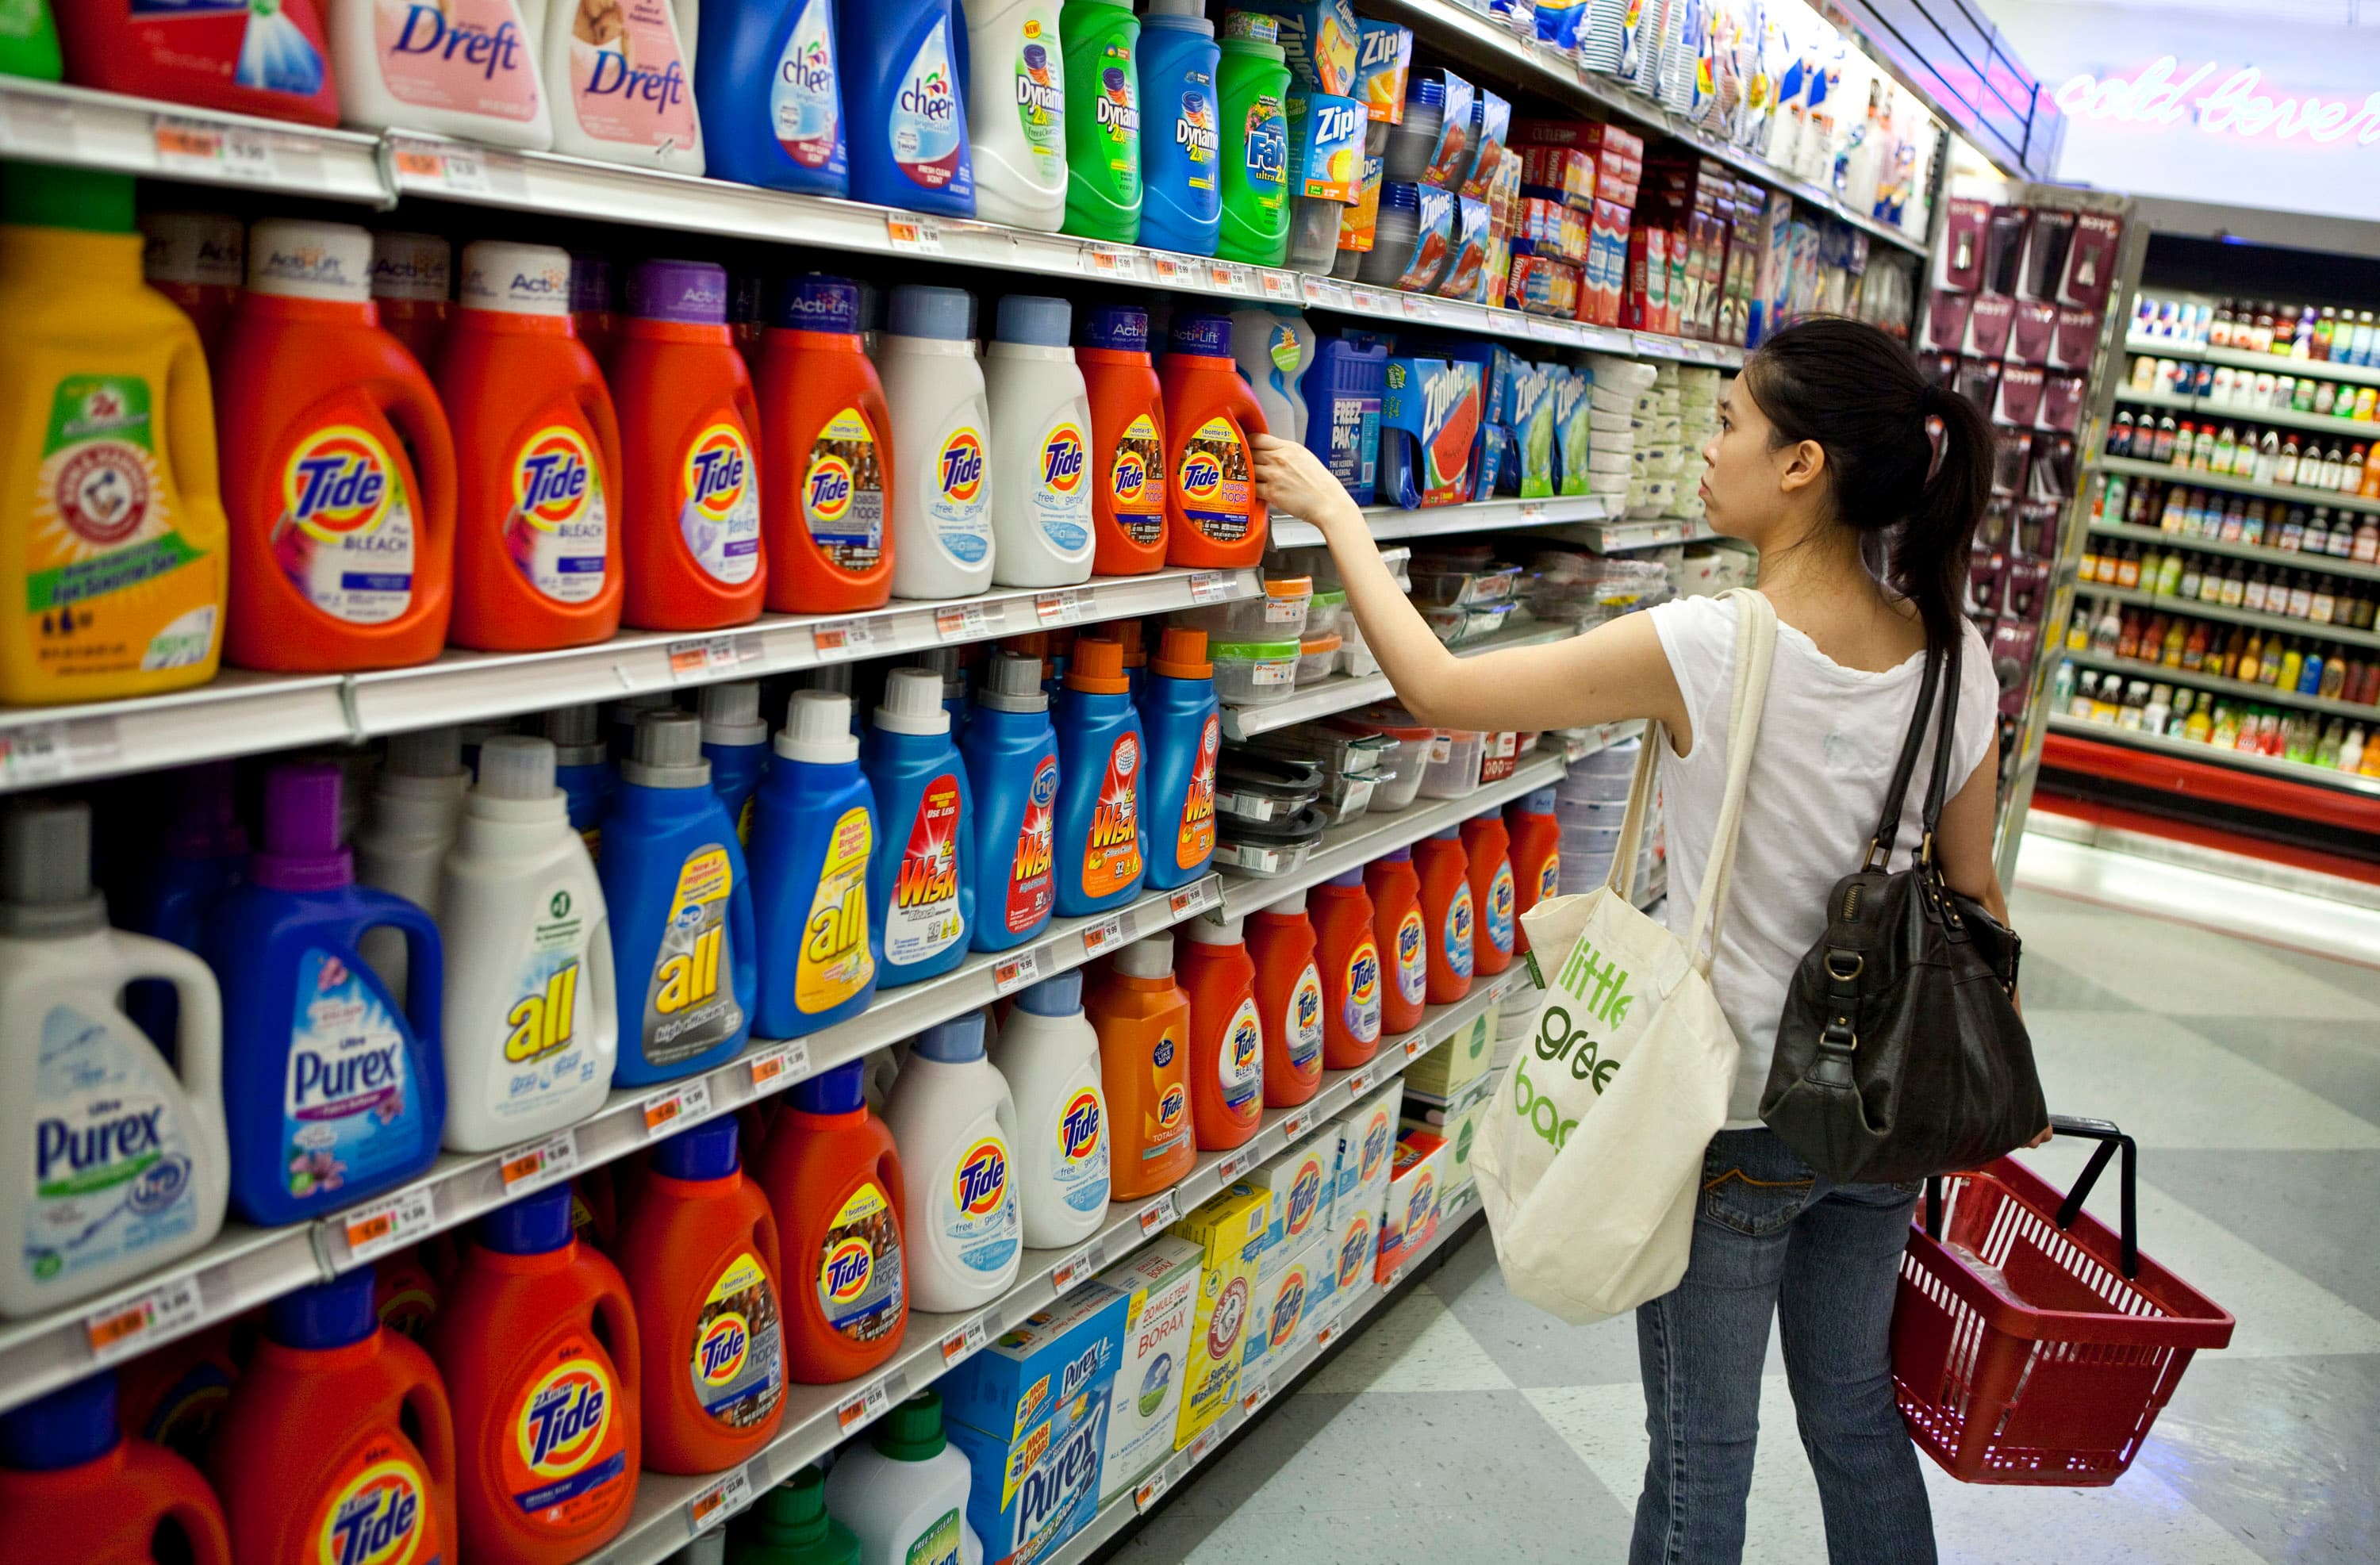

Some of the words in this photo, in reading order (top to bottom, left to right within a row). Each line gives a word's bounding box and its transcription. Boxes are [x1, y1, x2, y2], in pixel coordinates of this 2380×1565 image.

[393, 3, 520, 79] Dreft
[585, 50, 683, 113] Dreft
[784, 47, 833, 93] cheer
[901, 77, 953, 121] cheer
[2056, 55, 2217, 125] cold
[1096, 95, 1139, 133] Dynamo
[1176, 118, 1219, 151] Dynamo
[1189, 144, 1203, 163] 2x
[1247, 130, 1287, 171] Fab
[918, 165, 935, 175] FRESH
[935, 168, 951, 178] CLEAN
[927, 175, 942, 185] SCENT
[1256, 171, 1275, 182] ultra
[1422, 194, 1451, 232] Ziploc
[1462, 206, 1488, 243] Ziploc
[1334, 400, 1362, 424] FREEZ
[1422, 363, 1465, 446] Ziploc
[1514, 369, 1548, 426] Ziploc
[1556, 374, 1585, 426] Ziploc
[1332, 425, 1351, 451] PAK
[693, 450, 744, 504] Tide
[942, 447, 982, 493] Tide
[1046, 441, 1083, 484] Tide
[1115, 464, 1143, 494] Tide
[1184, 464, 1220, 492] Tide
[294, 457, 385, 520] Tide
[522, 453, 589, 512] Tide
[811, 473, 850, 508] Tide
[1038, 493, 1055, 503] free
[1144, 490, 1163, 504] hope
[1222, 490, 1249, 504] hope
[1223, 481, 1244, 492] loads
[342, 534, 409, 553] BLEACH
[557, 524, 605, 541] BLEACH
[1034, 771, 1055, 797] he
[1185, 778, 1215, 823] Wisk
[927, 810, 939, 819] USE
[942, 806, 954, 817] LESS
[1092, 802, 1138, 849] Wisk
[1015, 830, 1053, 882] Wisk
[1115, 861, 1125, 874] 32
[898, 854, 958, 909] Wisk
[808, 879, 865, 964] all
[908, 906, 935, 922] Bleach
[927, 922, 941, 938] 26
[1399, 924, 1419, 961] Tide
[654, 923, 724, 1015] all
[1351, 957, 1376, 995] Tide
[1559, 935, 1635, 1031] little
[504, 960, 580, 1064] all
[1298, 991, 1319, 1029] Tide
[339, 1036, 366, 1051] Ultra
[1157, 1050, 1171, 1061] LIKE
[1158, 1055, 1171, 1066] NEW
[1234, 1031, 1257, 1066] Tide
[294, 1042, 397, 1105] Purex
[1161, 1093, 1184, 1124] Tide
[36, 1106, 164, 1182] Purex
[1063, 1103, 1100, 1158] Tide
[1061, 1164, 1075, 1176] free
[1360, 1122, 1388, 1181] Tide
[959, 1155, 1005, 1213] Tide
[955, 1221, 973, 1233] free
[985, 1206, 1007, 1226] gentle
[1285, 1170, 1320, 1237] Tide
[1404, 1182, 1434, 1237] Tide
[827, 1252, 869, 1298] Tide
[873, 1264, 900, 1287] hope
[1146, 1260, 1177, 1279] BORAX
[1338, 1229, 1369, 1288] Tide
[1142, 1306, 1155, 1324] 20
[1155, 1293, 1174, 1313] MULE
[1174, 1279, 1191, 1299] TEAM
[1211, 1306, 1224, 1334] ARM
[1269, 1282, 1305, 1348] Tide
[1138, 1306, 1188, 1360] BORAX
[701, 1325, 745, 1381] Tide
[750, 1340, 778, 1366] hope
[1064, 1341, 1100, 1395] Purex
[1209, 1359, 1232, 1383] Super
[533, 1388, 551, 1408] 2X
[549, 1382, 574, 1402] ULTRA
[1027, 1387, 1048, 1416] LOADS
[1029, 1376, 1048, 1399] MORE
[1191, 1379, 1223, 1409] Washing
[528, 1385, 604, 1471] Tide
[1026, 1423, 1050, 1455] MORE
[1023, 1437, 1049, 1475] LOADS
[1110, 1451, 1120, 1461] ALL
[1121, 1437, 1142, 1454] NATURAL
[1016, 1406, 1102, 1546] Purex
[1080, 1450, 1097, 1500] 2
[331, 1491, 418, 1565] Tide
[913, 1535, 928, 1554] FREE
[1012, 1522, 1054, 1565] Color-Safe
[1054, 1486, 1082, 1528] Bleach
